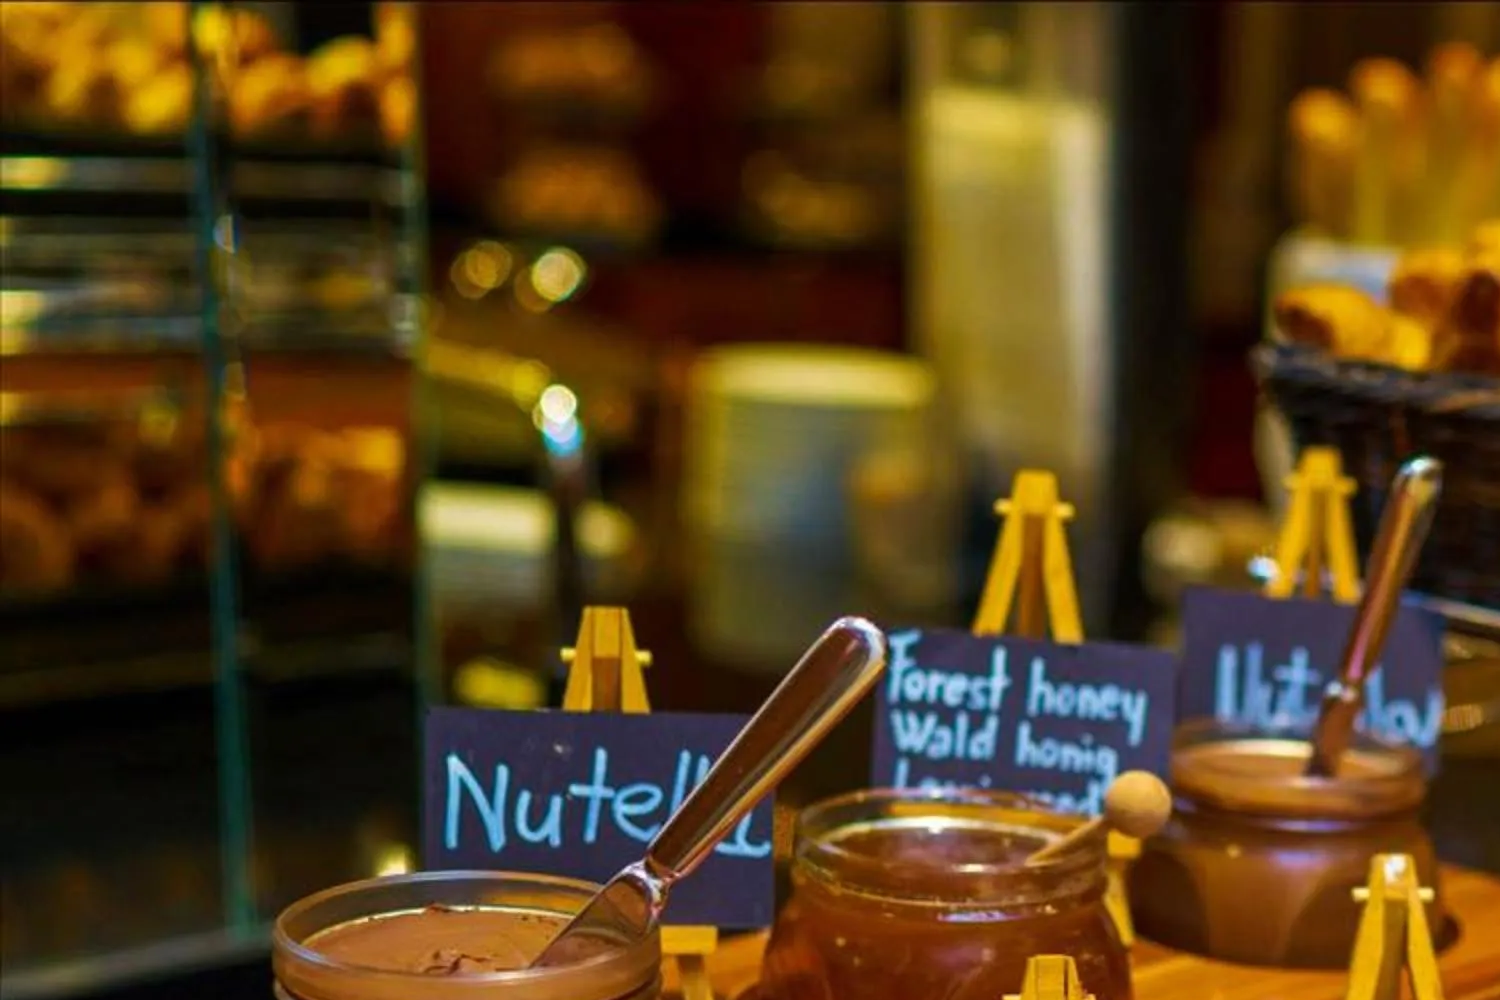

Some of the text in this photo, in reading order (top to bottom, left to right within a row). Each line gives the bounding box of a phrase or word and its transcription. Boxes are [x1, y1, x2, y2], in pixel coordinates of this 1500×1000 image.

[887, 630, 1148, 746] Forest honey
[444, 748, 772, 858] Nutel
[889, 708, 999, 760] Wald
[1014, 720, 1118, 794] honig
